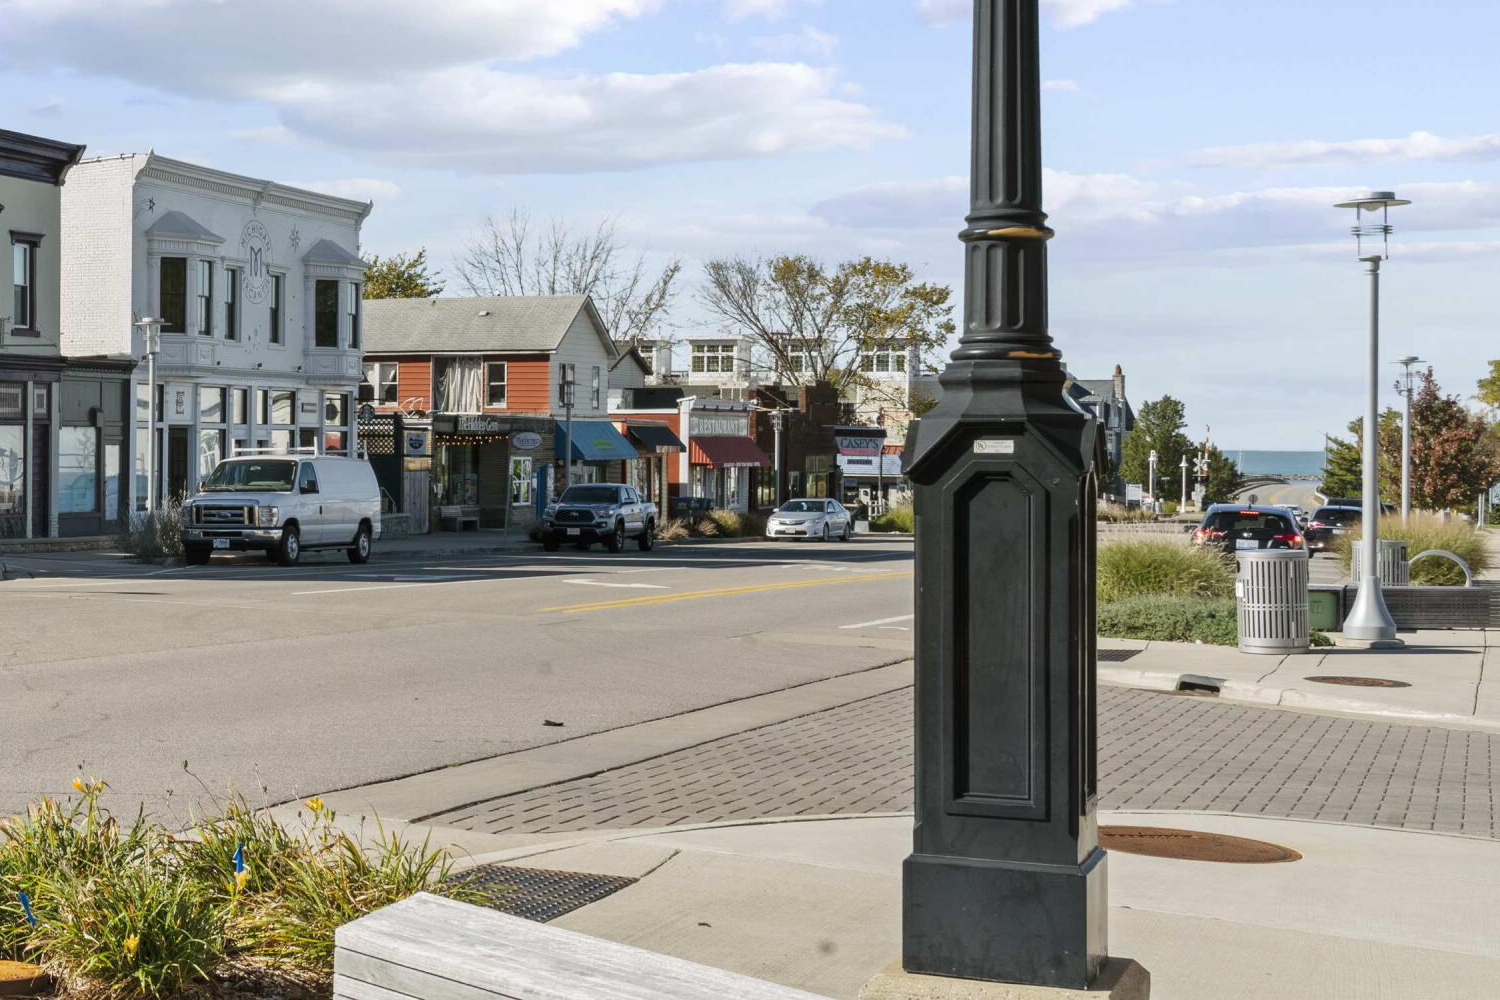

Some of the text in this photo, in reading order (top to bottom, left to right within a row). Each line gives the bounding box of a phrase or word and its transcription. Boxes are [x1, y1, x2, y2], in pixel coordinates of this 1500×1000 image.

[241, 221, 271, 252] MICHIGAN
[699, 419, 738, 435] RESTAURANT
[841, 438, 879, 448] CASEY'S
